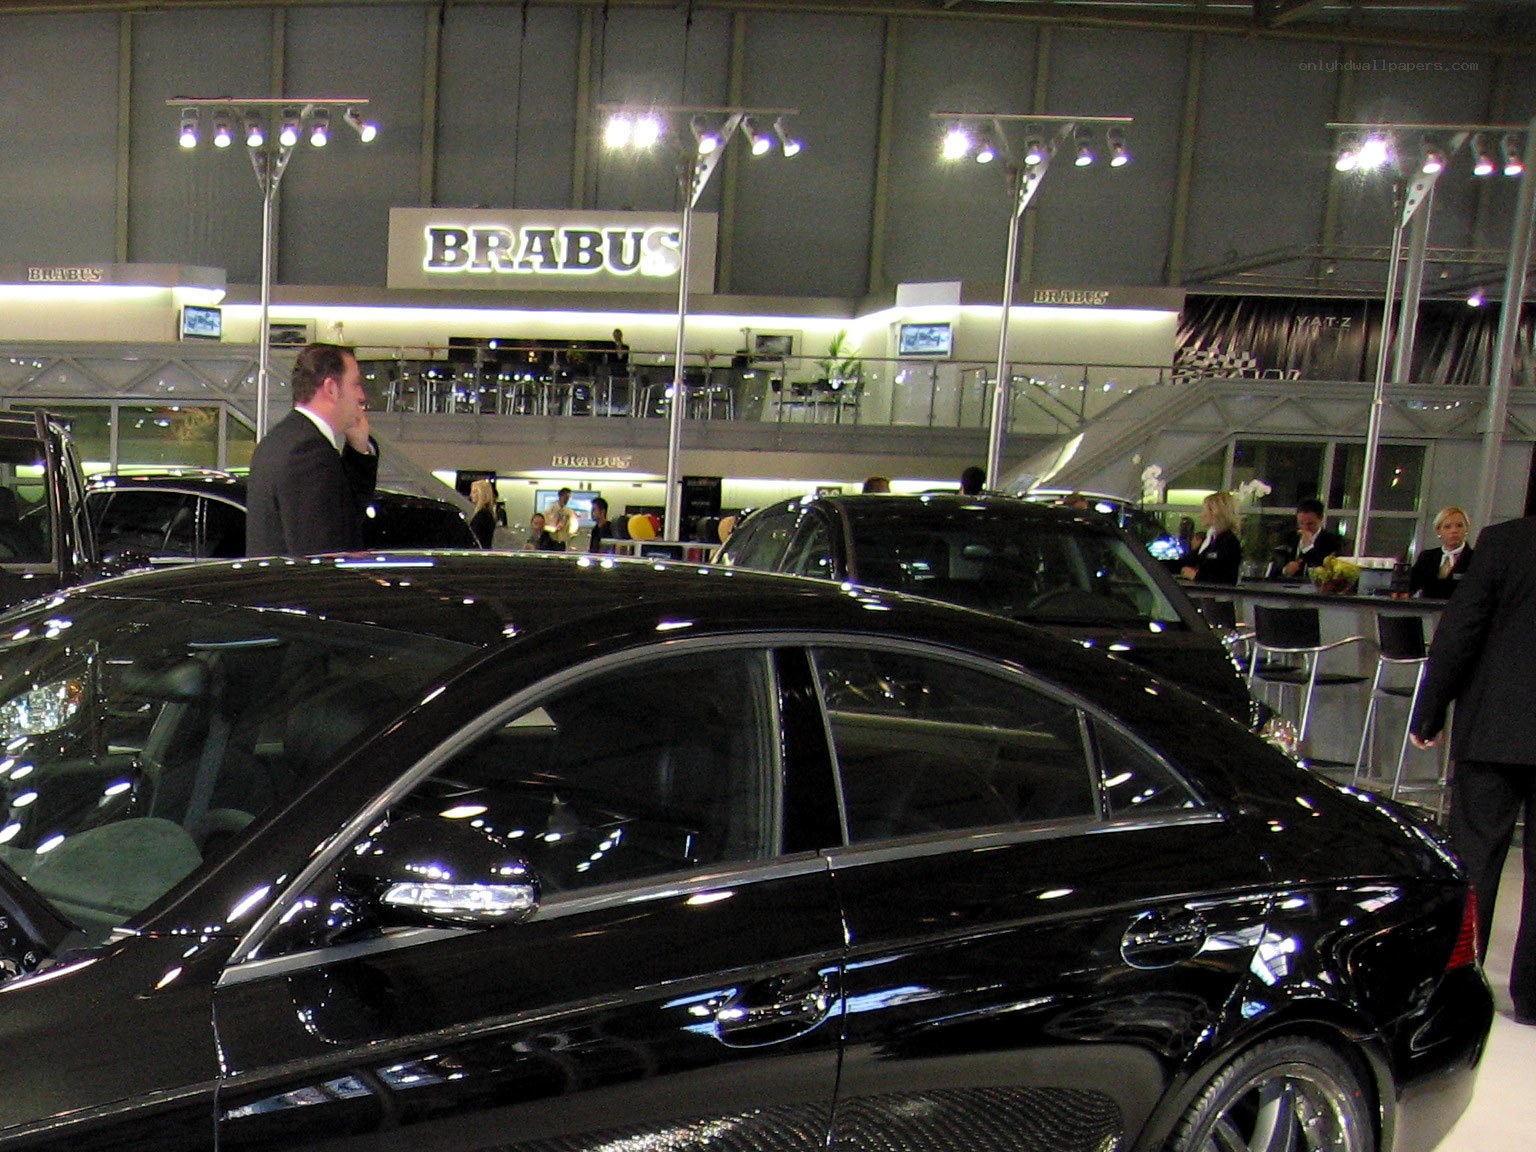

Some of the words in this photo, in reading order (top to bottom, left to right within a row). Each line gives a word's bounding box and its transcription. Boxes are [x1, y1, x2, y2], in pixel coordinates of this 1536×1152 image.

[423, 225, 682, 276] BRABUS
[27, 266, 104, 282] BRABUS
[1032, 289, 1110, 305] BRABUS
